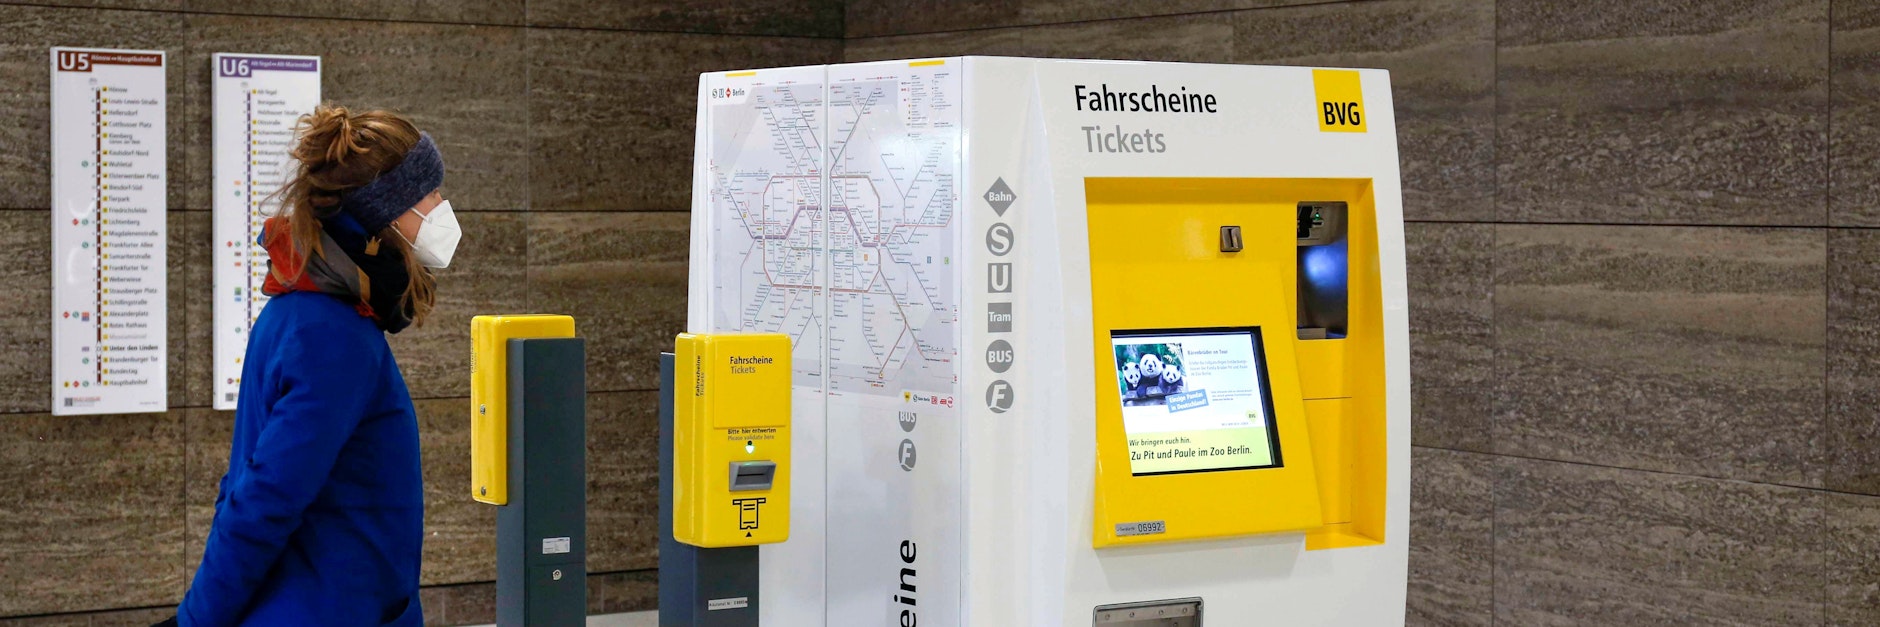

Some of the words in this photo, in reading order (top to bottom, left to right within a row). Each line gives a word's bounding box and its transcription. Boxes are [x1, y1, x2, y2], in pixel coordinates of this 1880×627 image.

[61, 52, 89, 71] U5
[222, 58, 249, 76] U6
[732, 88, 744, 96] Berlin
[1075, 84, 1217, 113] Fahrscheine
[1323, 102, 1361, 126] BVG
[1081, 125, 1166, 153] Tickets
[988, 191, 1012, 202] Bahn
[991, 264, 1009, 292] U
[988, 312, 1011, 322] Tram
[730, 356, 773, 364] Fahrscheine
[988, 350, 1012, 364] BUS
[731, 366, 756, 374] Tickets
[1140, 438, 1164, 447] bringen
[1132, 452, 1141, 460] Zu
[1144, 450, 1154, 460] Pit
[1157, 449, 1172, 459] und
[1174, 448, 1196, 458] Paule
[1198, 448, 1208, 456] im
[1210, 446, 1225, 456] Zoo
[1227, 445, 1252, 455] Berlin.
[1138, 522, 1161, 532] 06992
